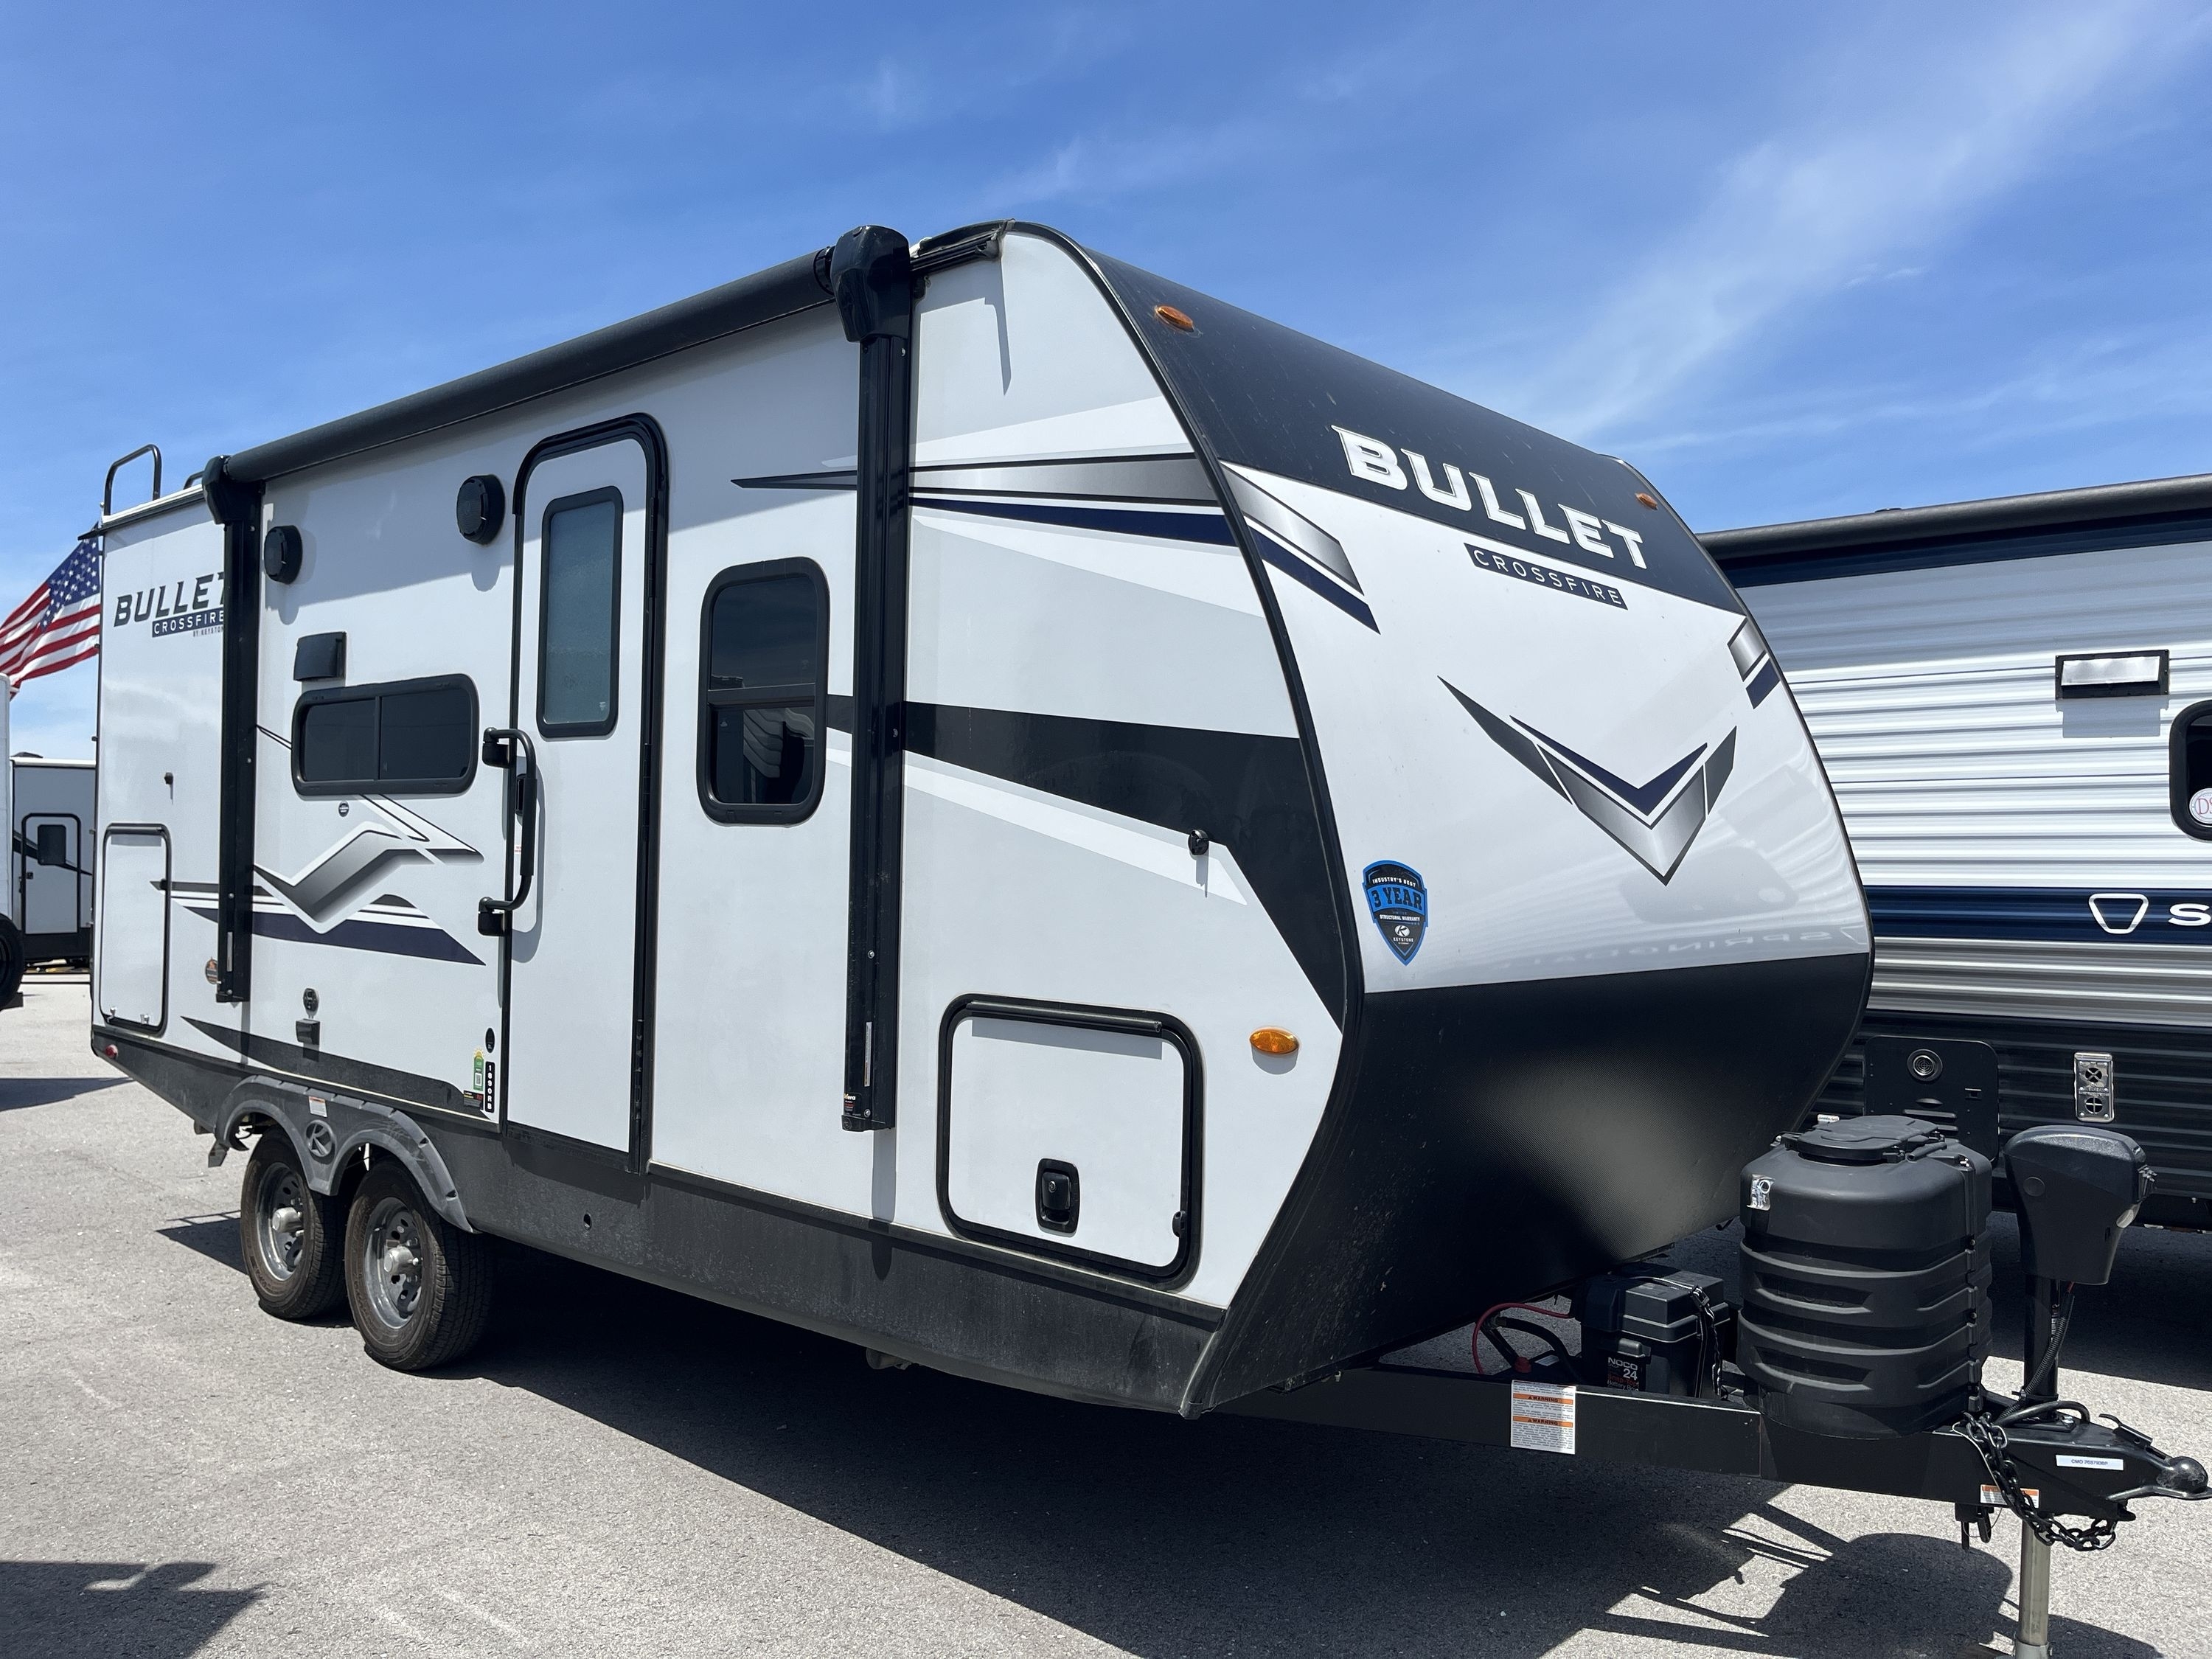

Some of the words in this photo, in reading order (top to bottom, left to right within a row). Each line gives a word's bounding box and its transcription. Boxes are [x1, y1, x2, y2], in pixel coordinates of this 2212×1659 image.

[1331, 425, 1646, 569] BULLET
[1474, 550, 1622, 605] CROSSFIRE
[153, 610, 224, 635] CROSSFIRE
[1403, 879, 1416, 887] BEST
[1371, 889, 1381, 908] 3
[1382, 887, 1422, 911] YEAR
[1608, 1357, 1638, 1370] NOCO
[1623, 1368, 1638, 1380] 24
